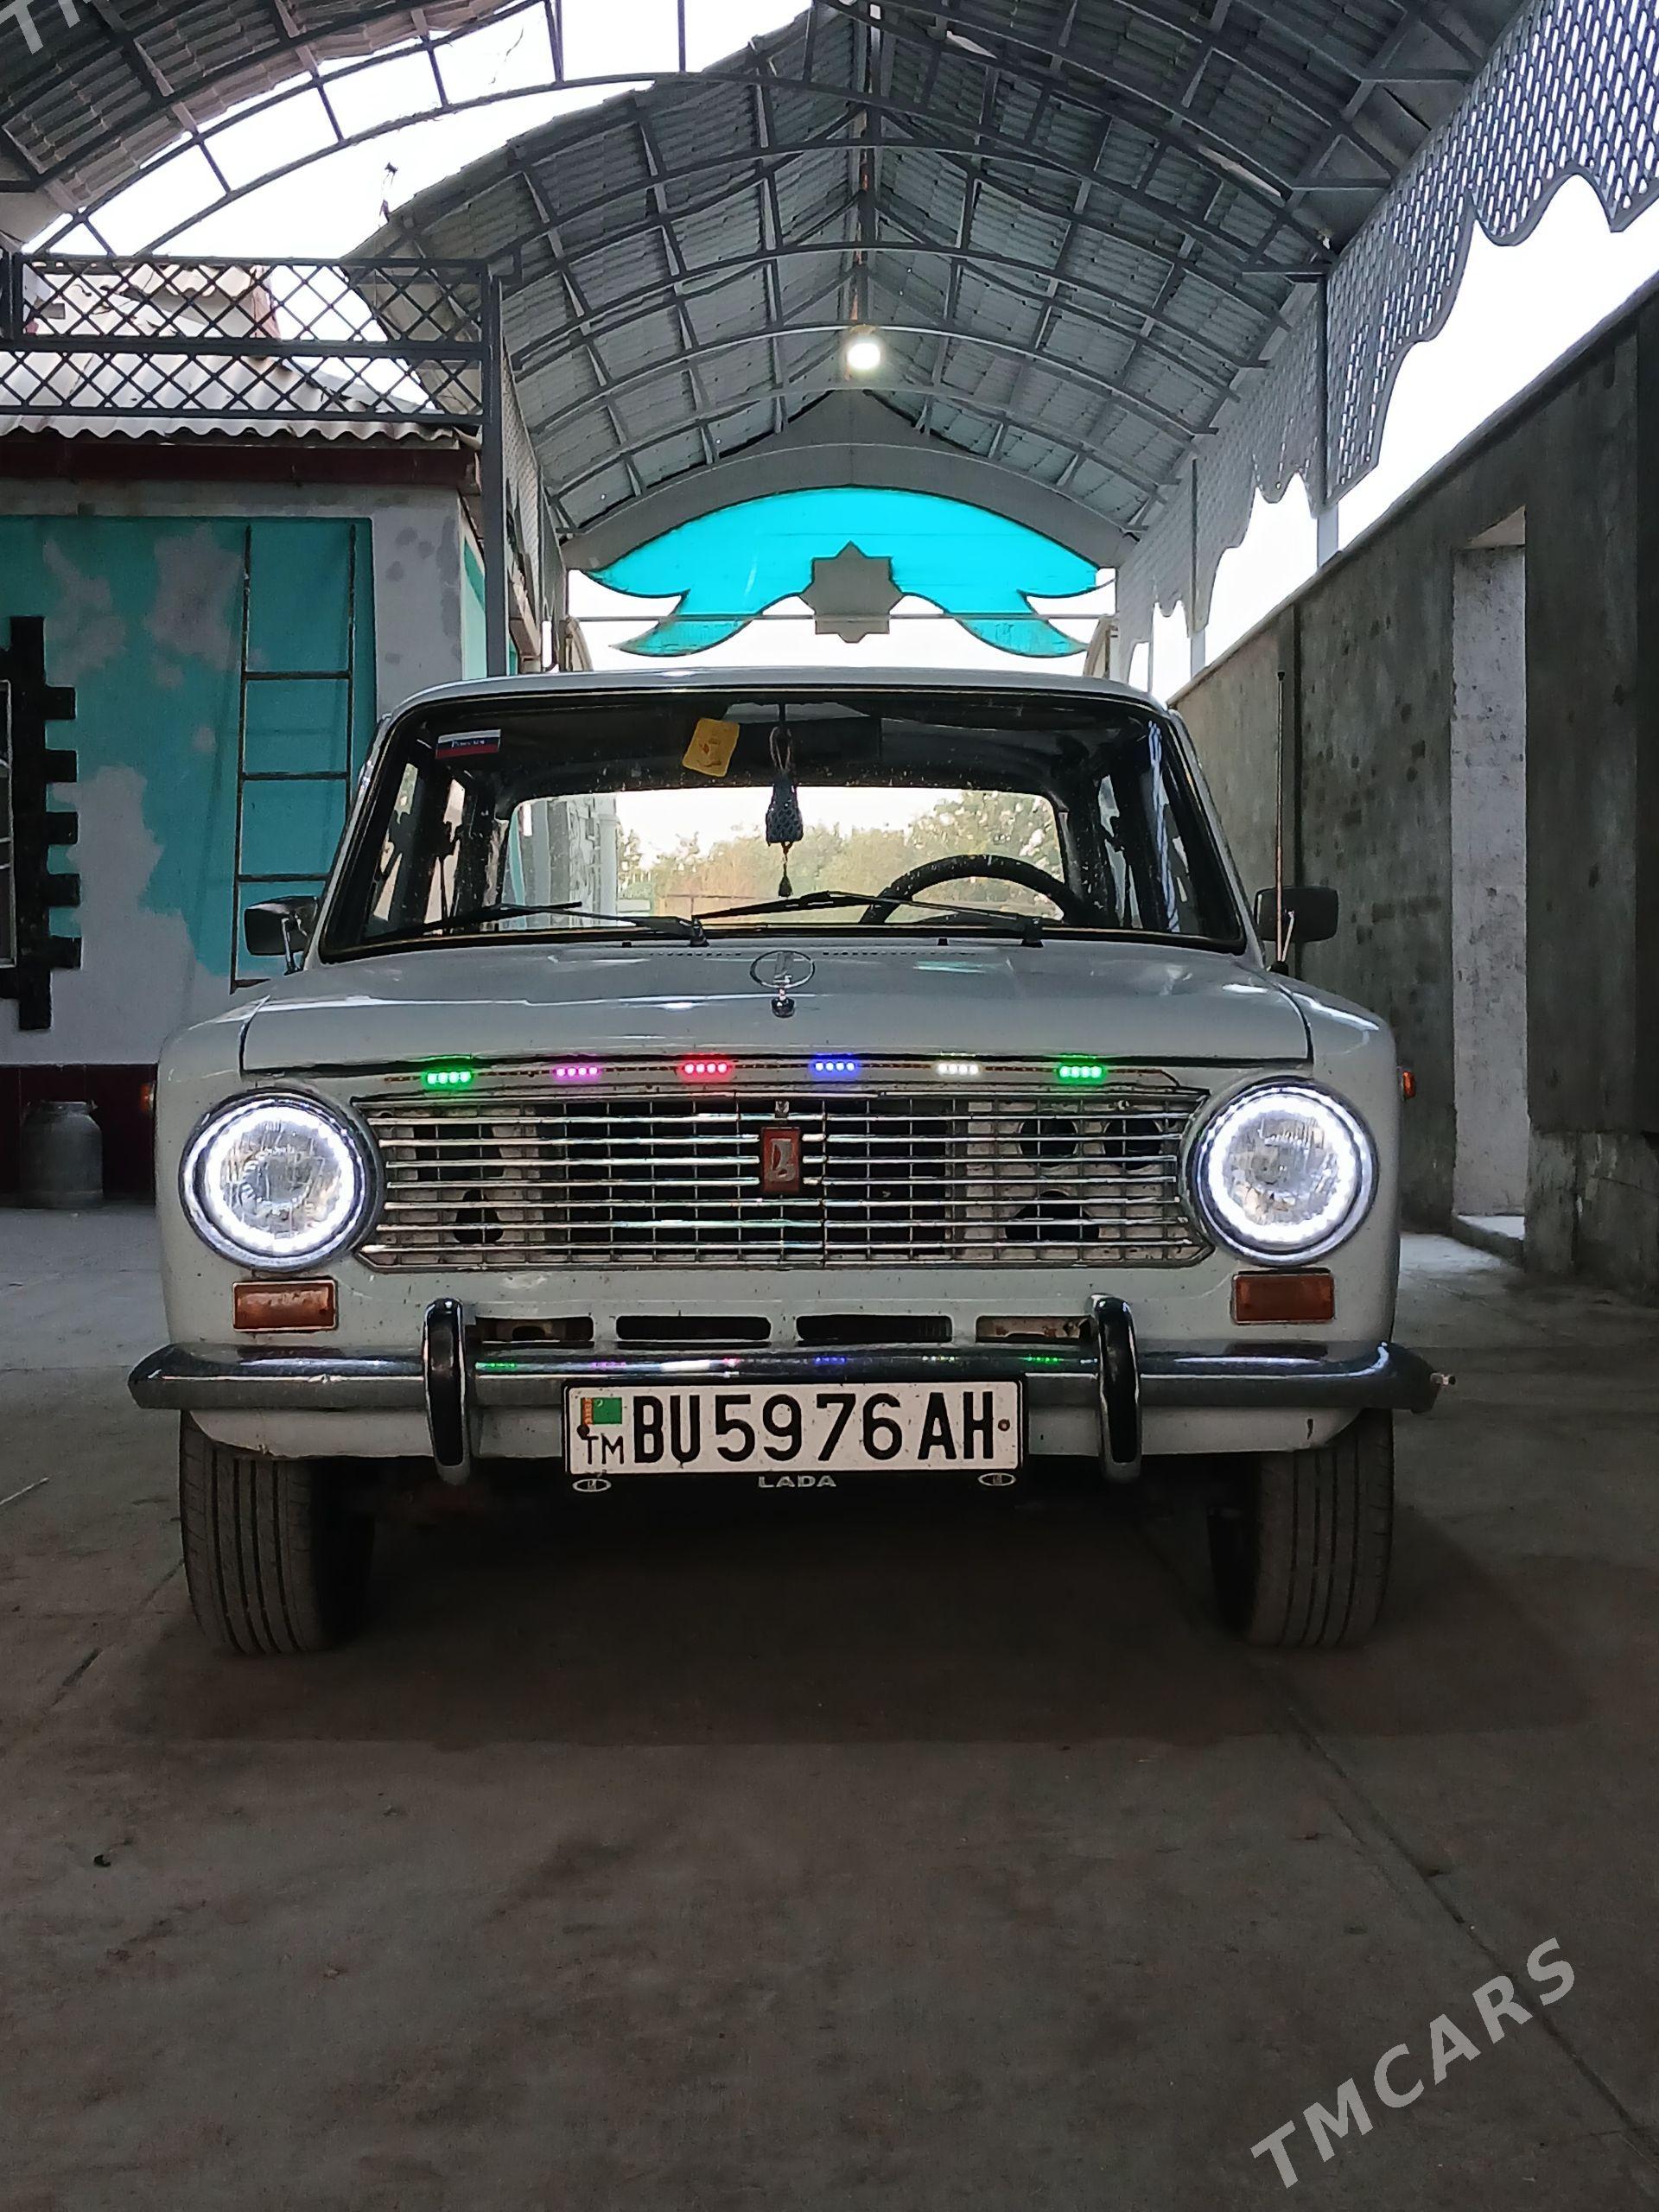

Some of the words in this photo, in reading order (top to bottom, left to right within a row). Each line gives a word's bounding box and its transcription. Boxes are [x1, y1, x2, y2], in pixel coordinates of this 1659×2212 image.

[632, 1391, 995, 1464] BU5976AH
[581, 1433, 624, 1465] TM
[758, 1475, 837, 1488] LADA
